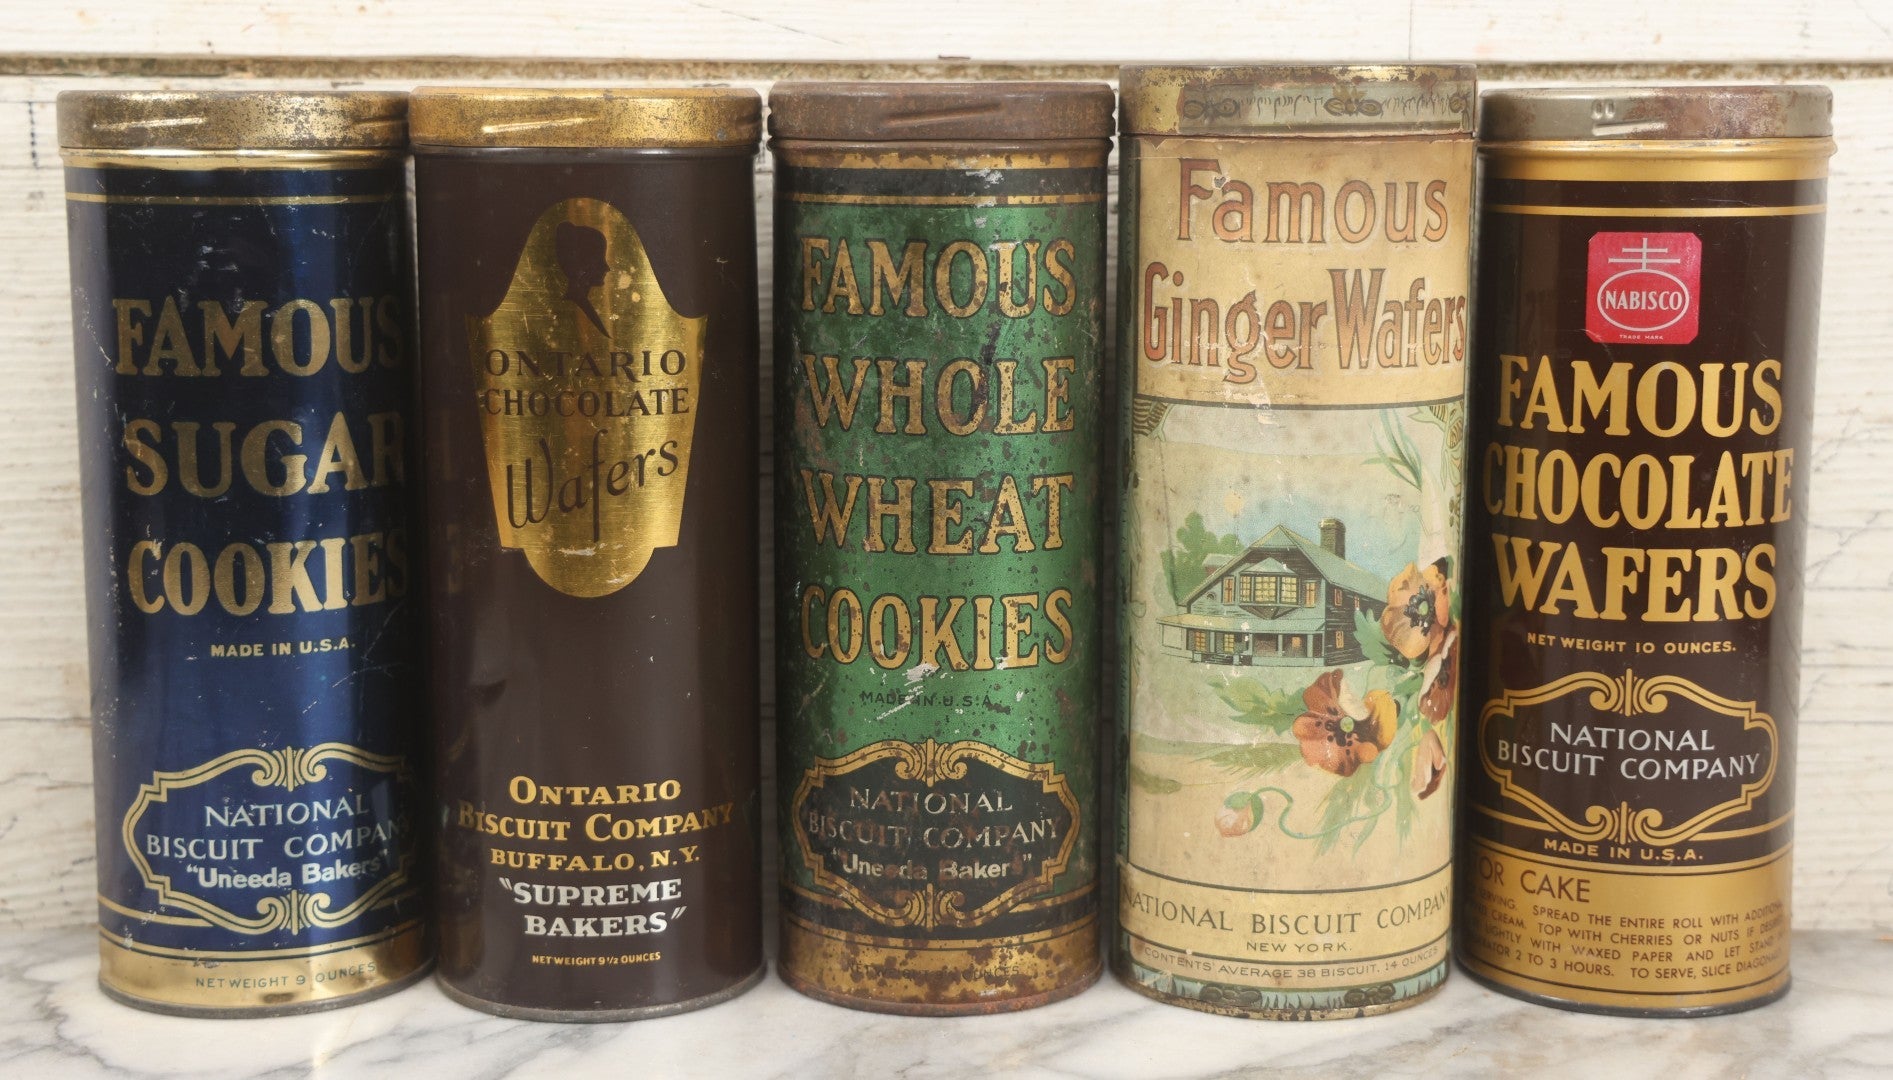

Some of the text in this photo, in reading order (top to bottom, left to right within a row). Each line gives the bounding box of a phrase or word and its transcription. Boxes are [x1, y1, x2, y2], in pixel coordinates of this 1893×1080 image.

[1176, 157, 1449, 245] Famous
[801, 236, 1077, 318] FAMOUS
[1604, 289, 1683, 311] NABISCO
[112, 294, 401, 378] FAMOUS
[1143, 261, 1466, 384] Ginger Wafers
[484, 348, 687, 383] ONTARIO
[483, 387, 690, 418] CHOCOLATE
[801, 354, 1076, 437] WHOLE
[1496, 354, 1782, 438] FAMOUS
[124, 411, 404, 499] SUGAR
[506, 428, 679, 543] Wafers
[1482, 441, 1795, 530] CHOCOLATE
[800, 469, 1074, 555] WHEAT
[127, 529, 406, 617] COOKIES
[1490, 532, 1778, 622] WAFERS
[800, 583, 1074, 672] COOKIES
[1527, 632, 1738, 654] NET WEIGHT 10 OUNCES.
[210, 637, 356, 658] MADE IN U.S.A.
[862, 690, 905, 705] MADE
[1549, 721, 1715, 752] NATIONAL
[1497, 738, 1760, 781] BISCUIT COMPANY
[509, 775, 682, 806] ONTARIO
[850, 787, 1012, 815] NATIONAL
[205, 794, 370, 828] NATIONAL
[457, 799, 734, 842] BISCUIT COMPANY
[146, 833, 264, 861] BISCUIT
[808, 811, 1059, 849] BISCUIT COMPANY
[490, 847, 645, 873] BUFFALO,
[1543, 837, 1705, 861] MADE IN U.S.A.
[498, 877, 682, 907] "SUPREME
[1520, 869, 1591, 904] CAKE
[524, 905, 688, 938] BAKERS"
[1122, 884, 1450, 936] NATIONAL BISCUIT COMPAN
[1532, 904, 1580, 923] SPREAD
[1587, 913, 1612, 927] THE
[1620, 916, 1665, 929] ENTIRE
[1672, 917, 1703, 929] ROLL
[1710, 912, 1739, 927] WITH
[1246, 940, 1353, 954] NEW YORK.
[1530, 937, 1561, 953] WITH
[1571, 944, 1621, 961] WAXED
[1632, 950, 1673, 963] PAPER
[1685, 949, 1714, 962] AND
[1724, 945, 1741, 959] LET
[1537, 922, 1562, 936] TOP
[1567, 928, 1602, 943] WITH
[1610, 932, 1673, 946] CHERRIES
[1683, 934, 1702, 946] OR
[1710, 929, 1740, 944] NUTS
[1746, 926, 1754, 938] IF
[195, 961, 376, 989] NET WEIGHT 9 OUNCES
[532, 954, 551, 965] NET
[553, 955, 596, 966] WEIGHT
[620, 951, 662, 965] OUNCES
[1217, 964, 1293, 979] AVERAGE
[1297, 968, 1317, 979] 38
[1385, 959, 1398, 972] 14
[1401, 945, 1439, 968] OUNCES
[1515, 951, 1522, 961] 2
[1528, 952, 1544, 966] TO
[1550, 957, 1557, 969] 3
[1563, 960, 1615, 977] HOURS.
[1630, 967, 1650, 979] TO
[1654, 967, 1697, 980] SERVE,
[1701, 963, 1731, 978] SLICE
